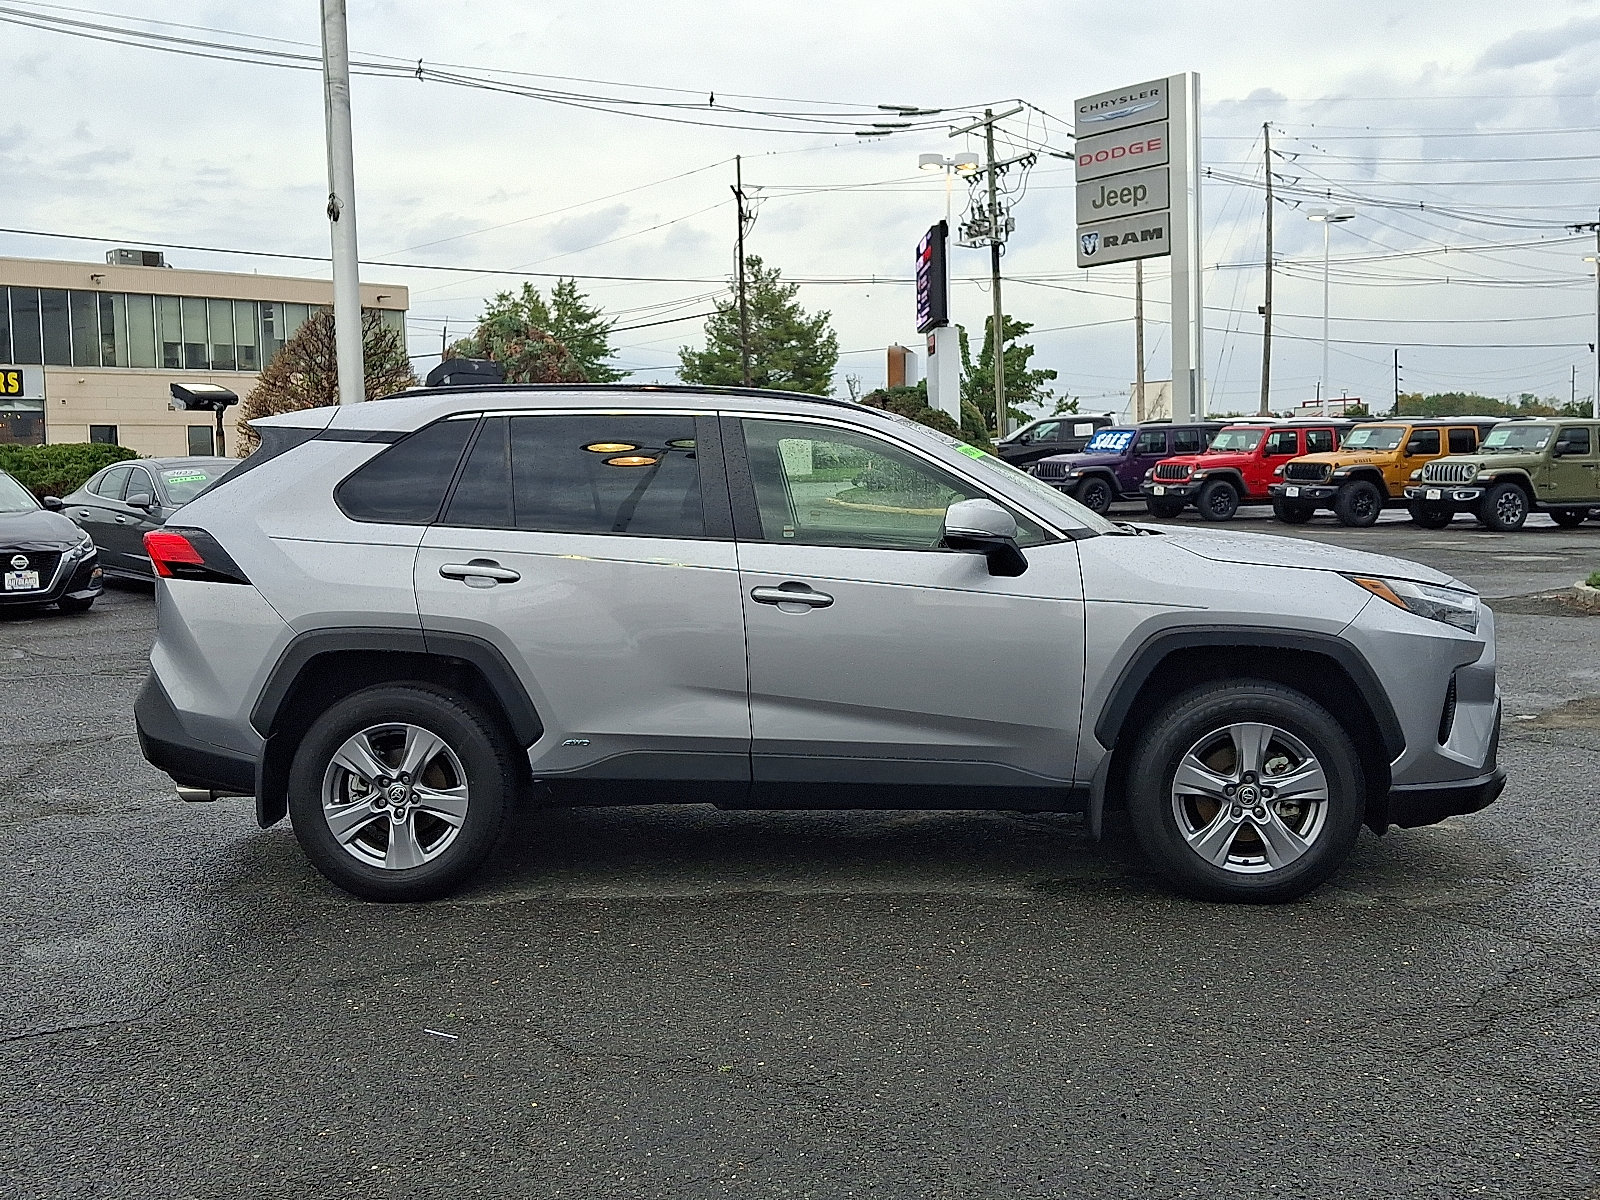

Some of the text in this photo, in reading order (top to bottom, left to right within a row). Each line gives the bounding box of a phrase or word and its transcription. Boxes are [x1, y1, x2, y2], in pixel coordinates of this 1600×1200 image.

[1079, 88, 1160, 114] CHRYSLER
[1079, 137, 1162, 167] DODGE
[1092, 183, 1148, 210] Jeep
[1103, 227, 1163, 248] RAM
[1090, 433, 1132, 450] SALE
